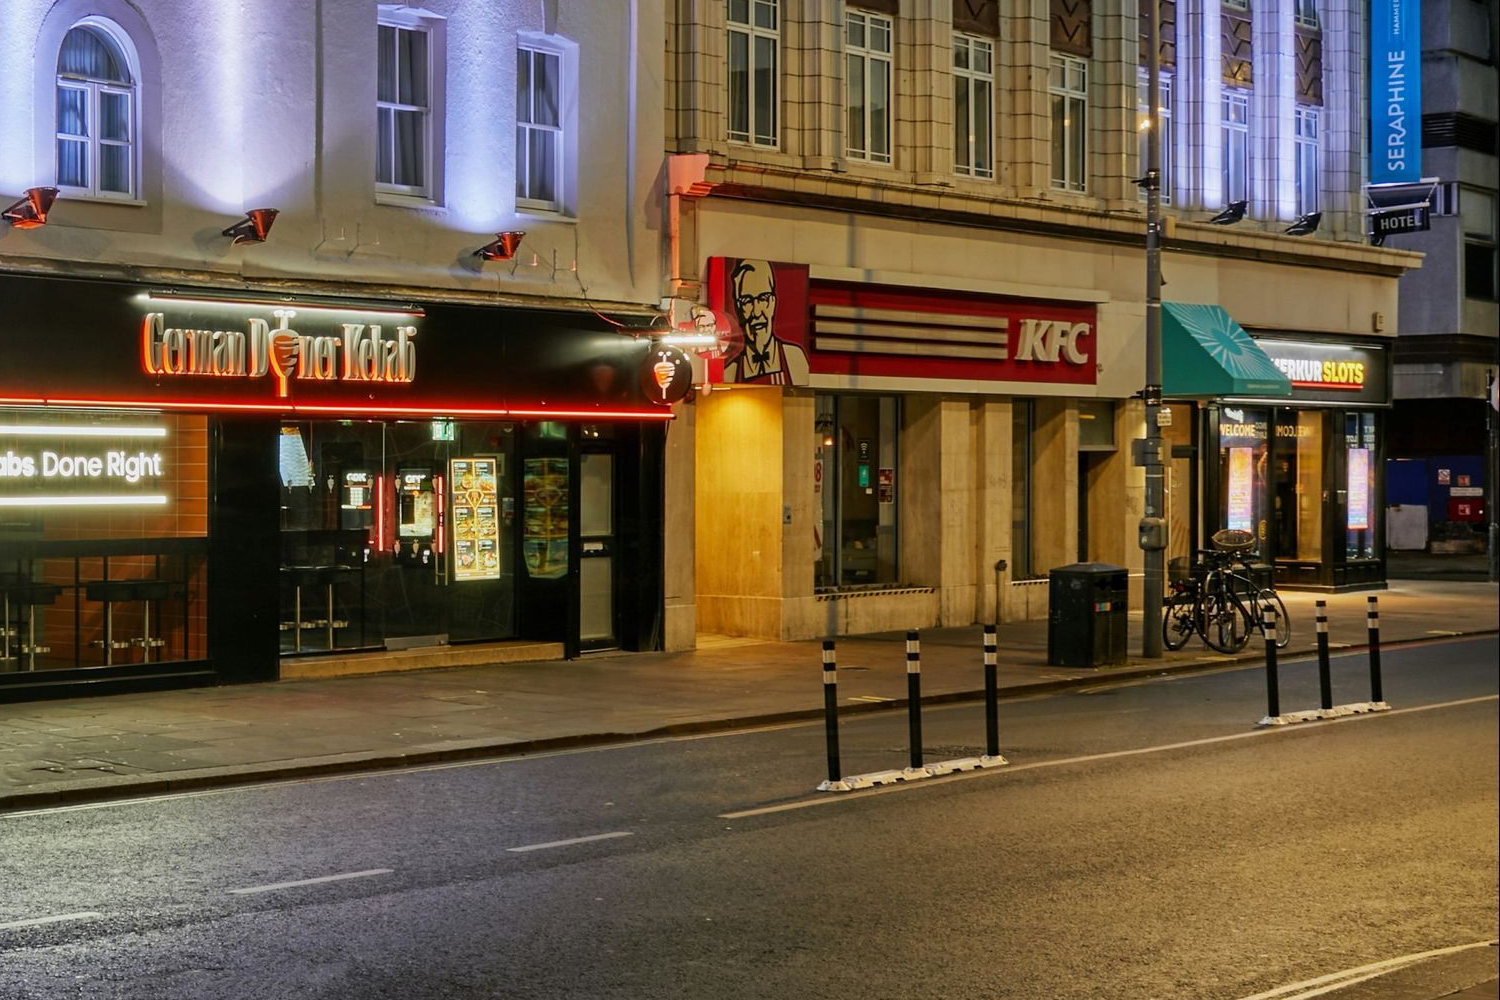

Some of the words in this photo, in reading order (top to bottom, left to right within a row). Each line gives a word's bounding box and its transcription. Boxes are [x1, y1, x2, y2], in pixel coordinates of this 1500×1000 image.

[1387, 50, 1407, 172] SERAPHINE
[1380, 215, 1423, 230] HOTEL
[142, 312, 247, 377] German
[342, 323, 418, 383] Kebab
[1014, 318, 1090, 365] KFC
[1323, 360, 1364, 384] SLOTS
[43, 451, 102, 477] Done
